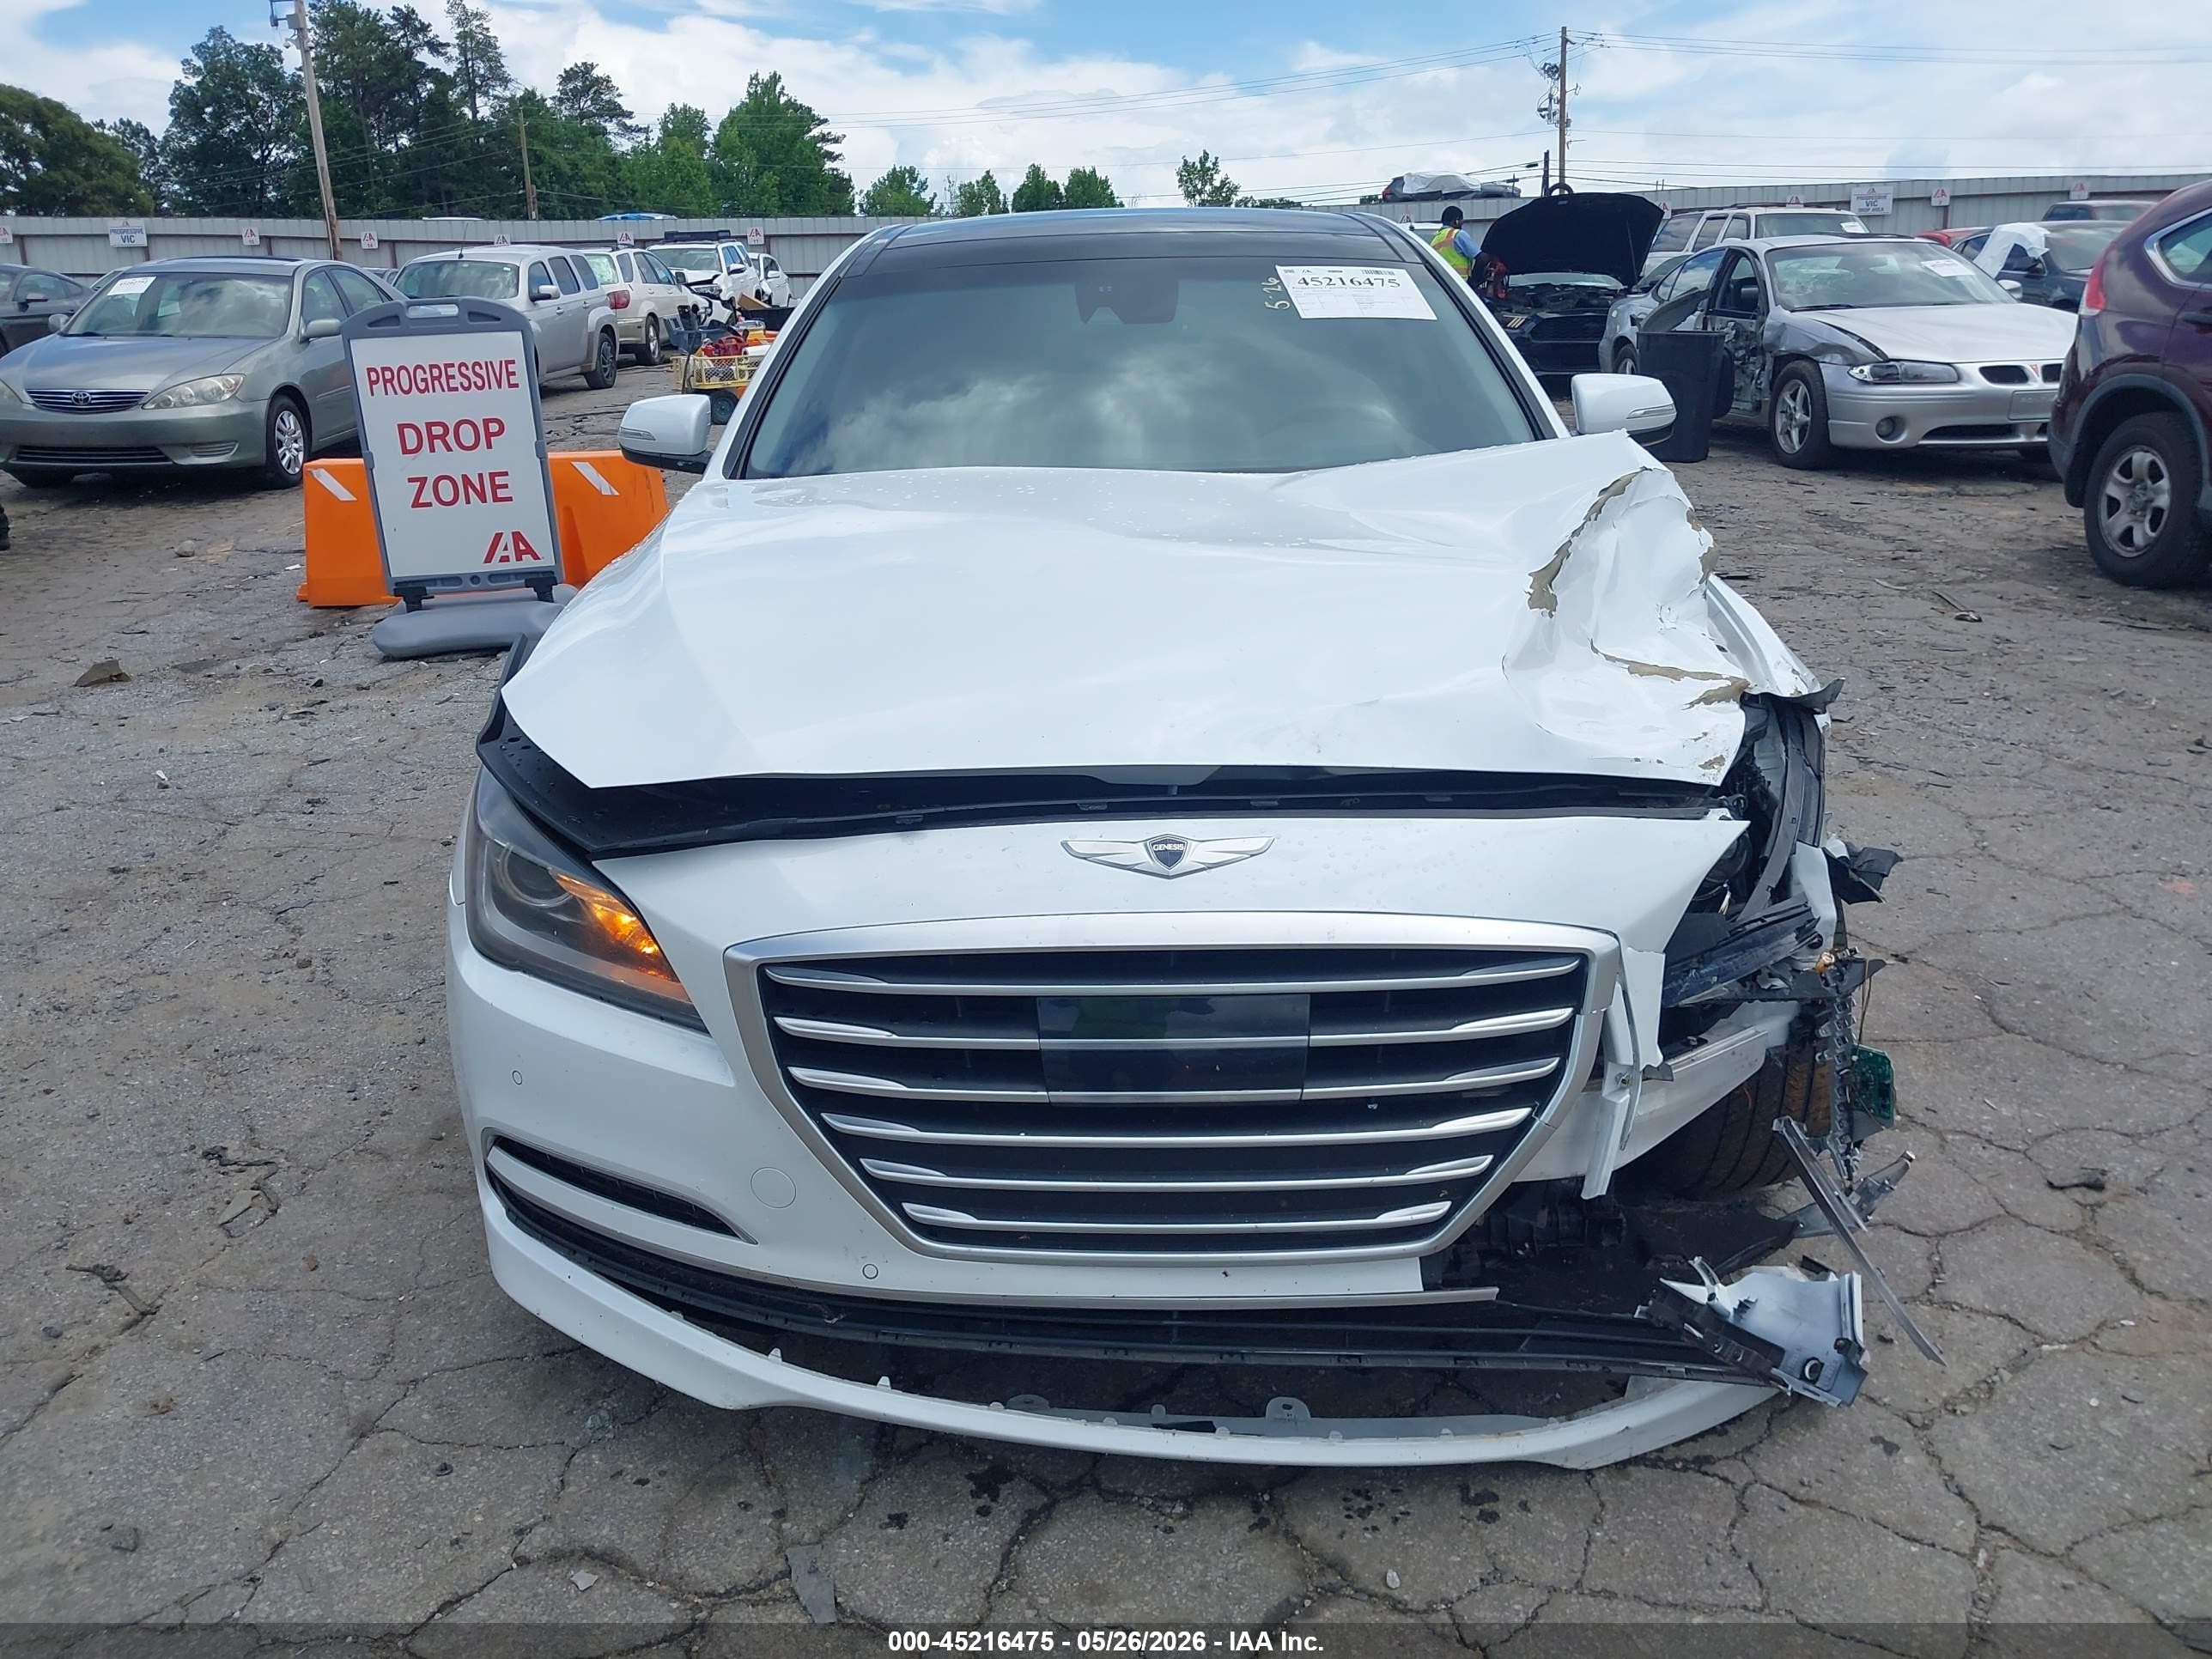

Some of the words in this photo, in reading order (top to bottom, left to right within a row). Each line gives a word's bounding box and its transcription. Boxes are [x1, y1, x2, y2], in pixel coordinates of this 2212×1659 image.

[120, 234, 136, 244] VIC
[1297, 276, 1401, 289] 45216475
[366, 359, 520, 397] PROGRESSIVE
[397, 417, 506, 455] DROP
[407, 471, 514, 509] ZONE
